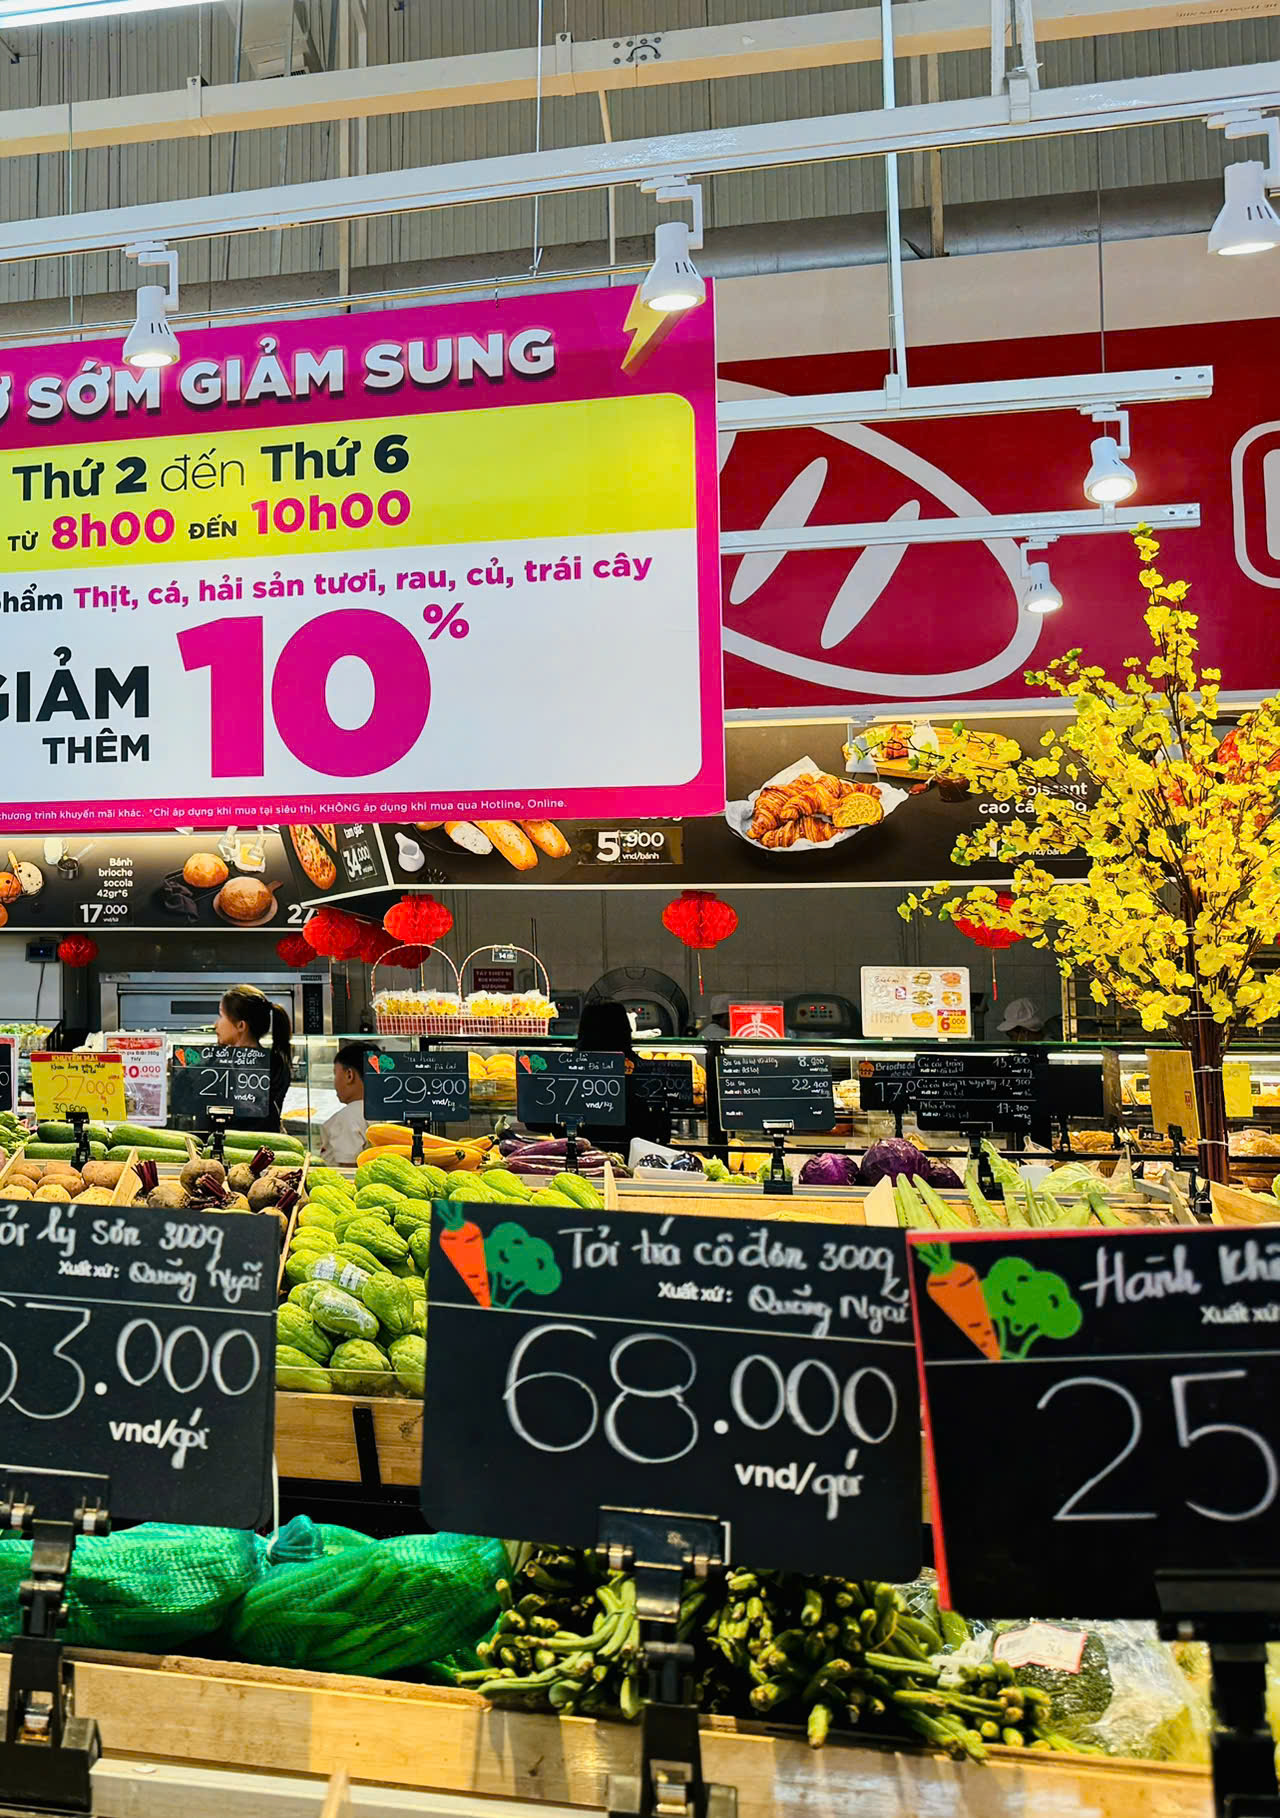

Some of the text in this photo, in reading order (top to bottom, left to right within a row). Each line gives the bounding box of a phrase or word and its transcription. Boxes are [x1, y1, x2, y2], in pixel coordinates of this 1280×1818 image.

[28, 361, 160, 420] SỚM
[180, 337, 343, 405] GIẢM
[364, 328, 555, 388] SUNG
[12, 434, 409, 501] Thứ 2 đến Thứ 6
[8, 489, 411, 551] TỪ 8h00 ĐẾN 10h00
[74, 585, 138, 612] Thịt,
[148, 581, 189, 607] cá,
[199, 571, 243, 602] hải
[253, 571, 304, 598] sản
[314, 568, 386, 596] tươi,
[396, 566, 456, 593] rau,
[467, 558, 514, 588] củ,
[524, 555, 583, 583] trái
[593, 552, 653, 583] cây
[43, 728, 149, 764] THÊM
[188, 807, 213, 818] dụng
[235, 807, 257, 815] mua
[319, 803, 361, 814] KHÔNG
[364, 804, 378, 814] áp
[380, 803, 407, 815] dụng
[411, 802, 427, 812] khi
[457, 803, 478, 812] qua
[979, 804, 1010, 814] cao
[99, 868, 133, 877] brioche
[110, 858, 133, 867] Bánh
[104, 879, 133, 887] socola
[80, 904, 128, 923] 17.000
[200, 1069, 271, 1099] 21.900
[384, 1076, 467, 1104] 29.900
[536, 1078, 621, 1105] 37.900
[874, 1080, 917, 1102] 17.0
[694, 1233, 734, 1267] cô
[59, 1260, 120, 1279] Xuất xứ:
[658, 1282, 697, 1301] Xuất
[700, 1285, 733, 1302] xứ:
[1202, 1306, 1248, 1324] Xuất
[503, 1323, 897, 1464] 68.000
